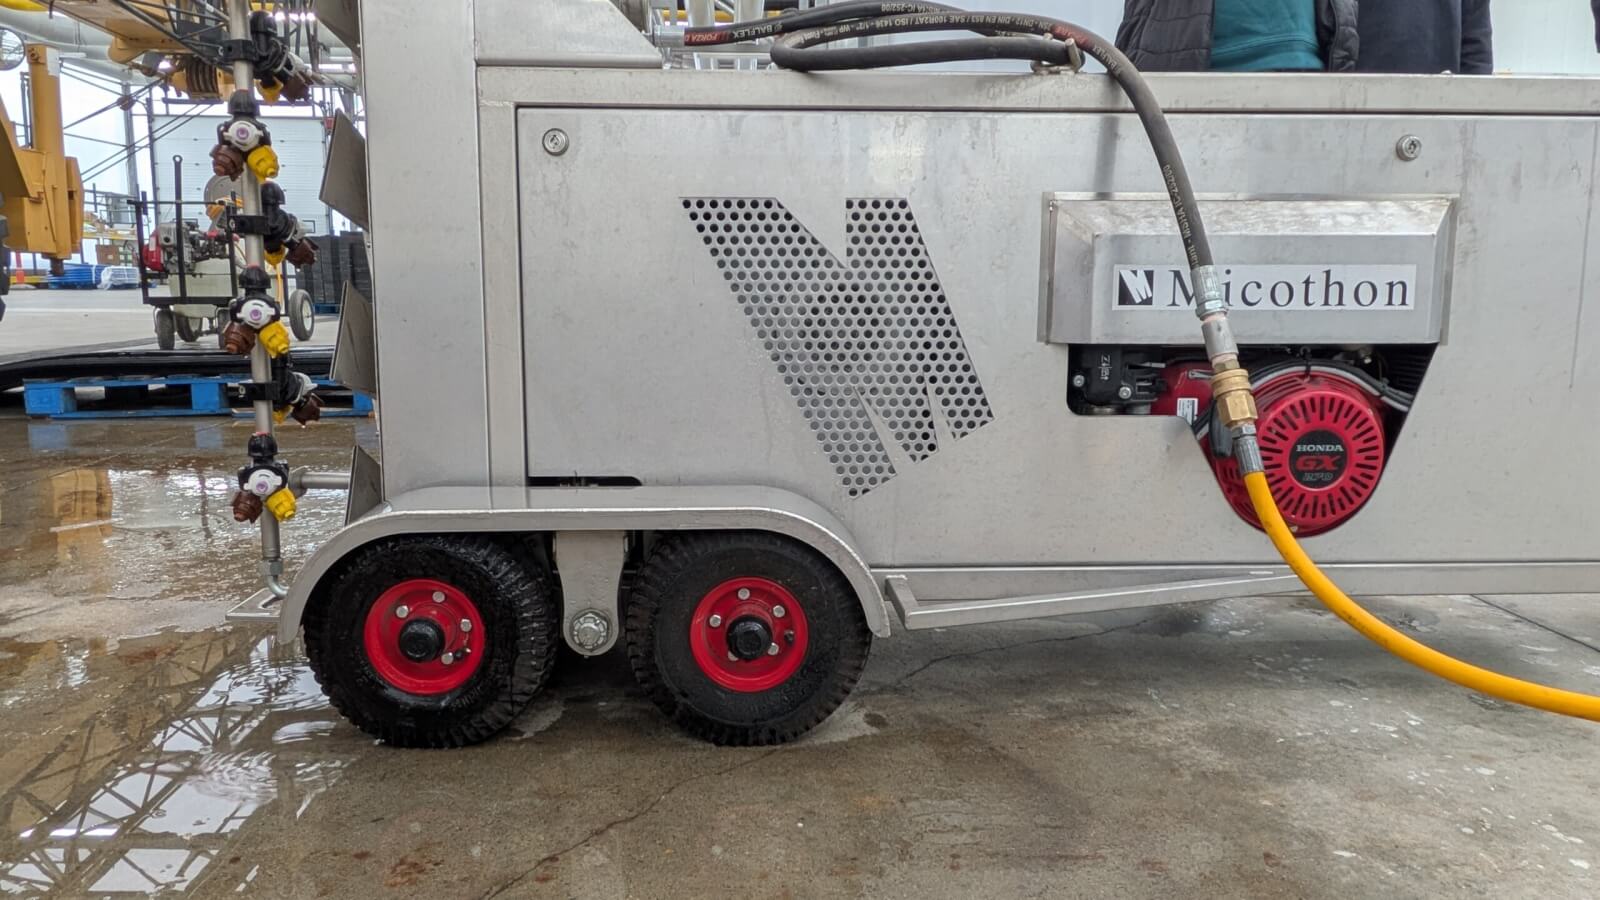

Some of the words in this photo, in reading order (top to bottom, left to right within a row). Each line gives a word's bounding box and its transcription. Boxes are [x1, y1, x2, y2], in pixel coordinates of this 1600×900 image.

[894, 17, 909, 26] ISO
[915, 15, 947, 24] 100R2AT
[949, 15, 966, 23] SAE
[732, 24, 773, 39] BALFLEX
[1296, 444, 1344, 452] HONDA
[1295, 454, 1342, 471] GX
